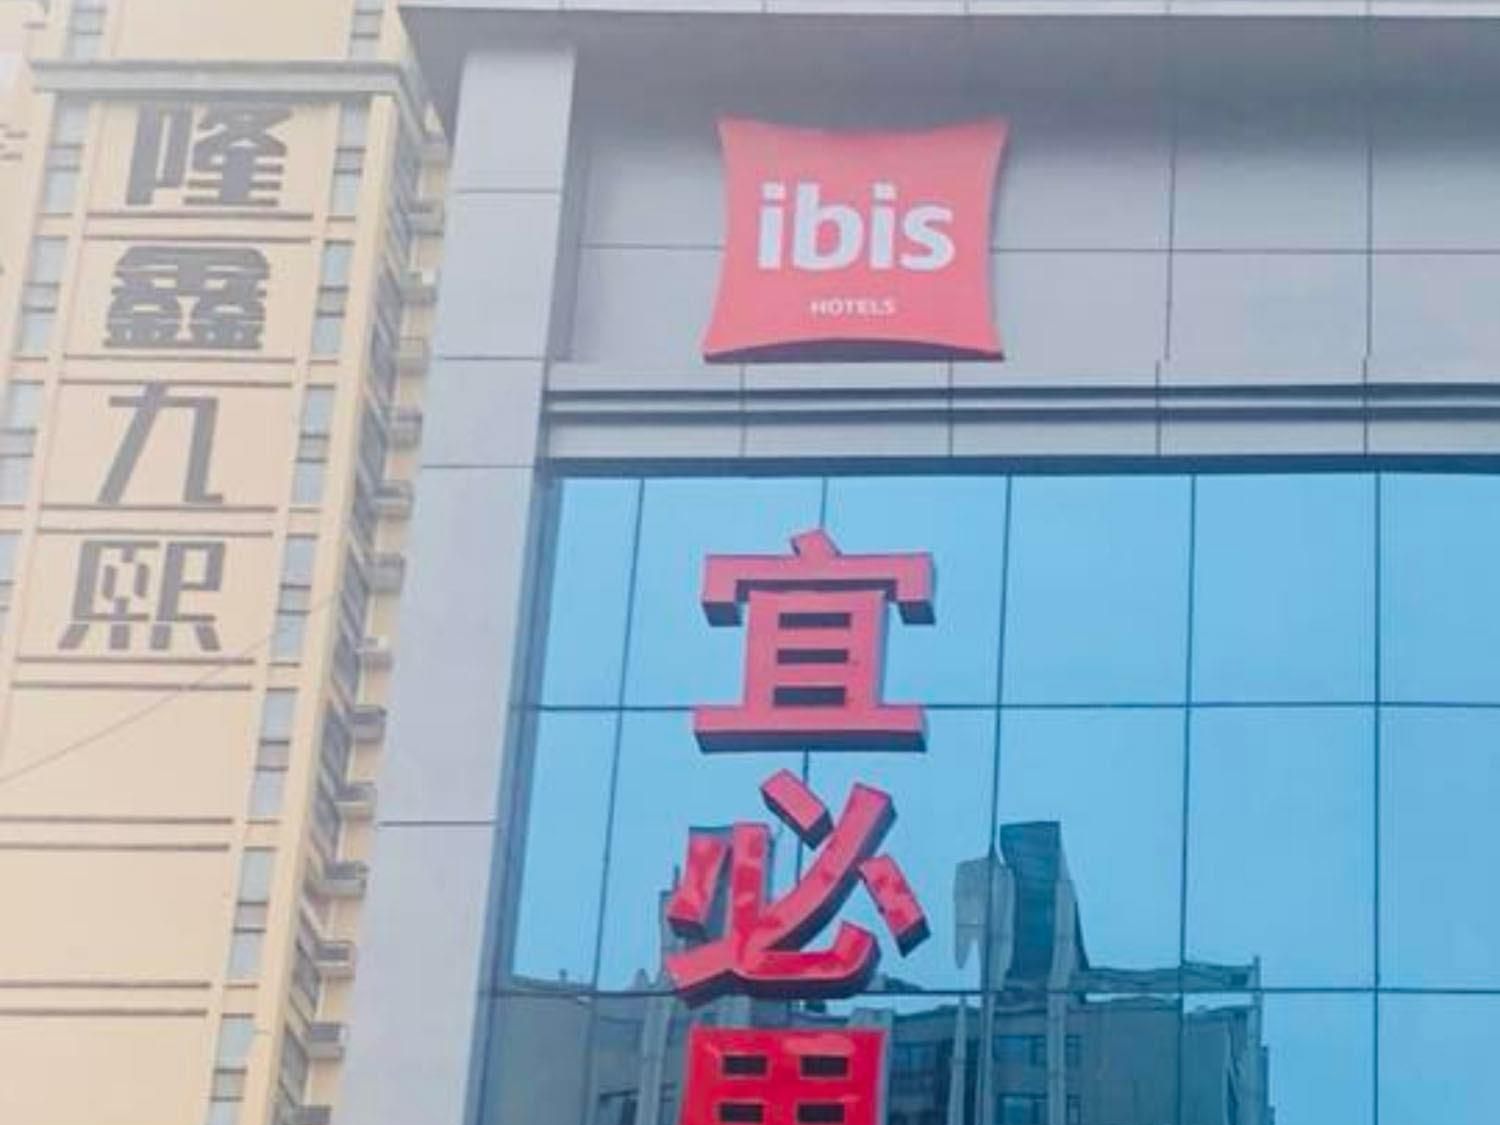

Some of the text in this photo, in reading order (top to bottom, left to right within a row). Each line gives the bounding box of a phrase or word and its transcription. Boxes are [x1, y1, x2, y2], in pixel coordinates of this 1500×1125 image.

[756, 182, 956, 271] ibis
[809, 296, 896, 317] HOTELS
[58, 103, 293, 653] 隆鑫九熙
